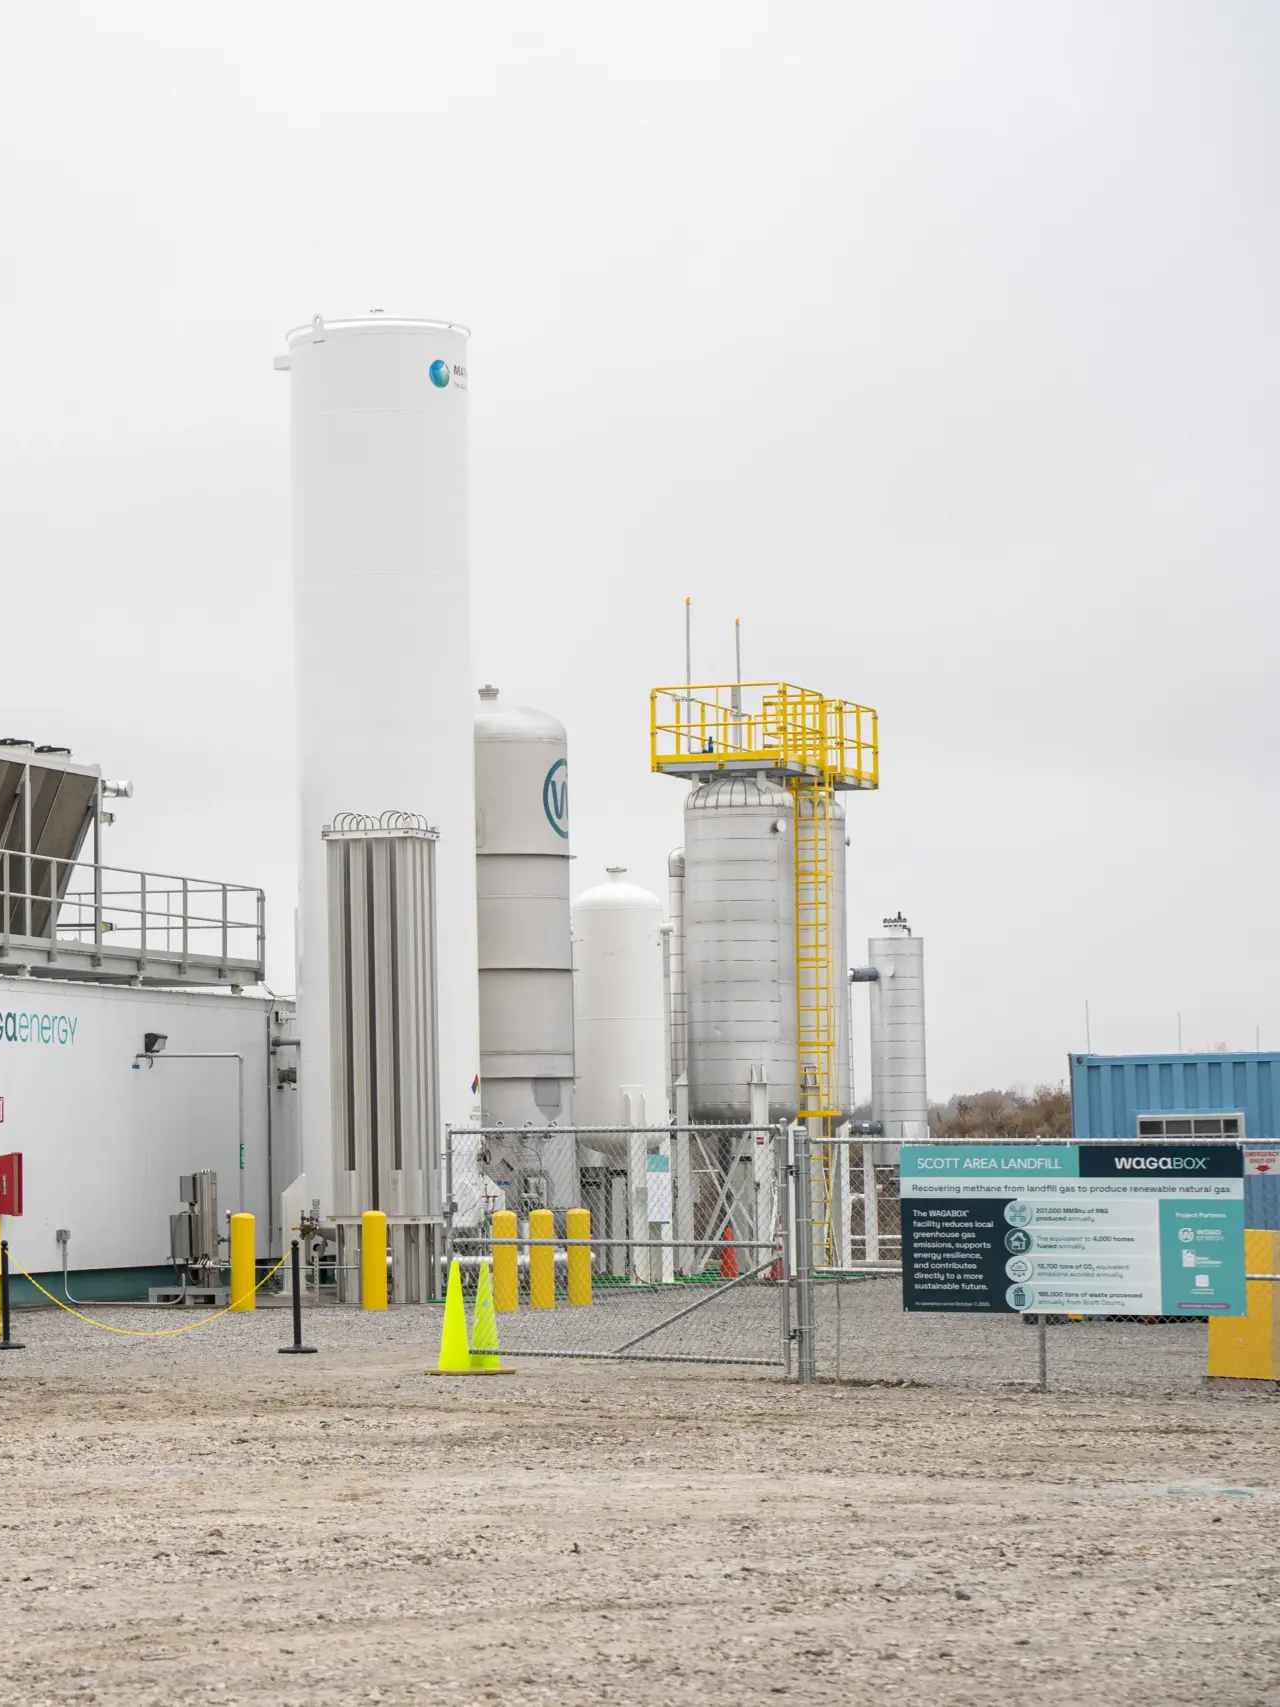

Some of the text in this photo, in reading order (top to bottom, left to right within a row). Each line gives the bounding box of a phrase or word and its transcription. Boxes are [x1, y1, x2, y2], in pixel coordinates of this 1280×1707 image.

[917, 1158, 1062, 1169] SCOTT AREA LANDFILL
[912, 1185, 960, 1194] Recovering
[963, 1185, 1002, 1193] methane
[1004, 1185, 1025, 1193] from
[1027, 1185, 1057, 1193] landfill
[1059, 1186, 1076, 1194] gas
[1090, 1185, 1127, 1195] produce
[1129, 1185, 1177, 1193] renewable
[1179, 1185, 1212, 1193] natural
[1214, 1187, 1231, 1195] gas
[912, 1209, 927, 1217] The
[913, 1220, 941, 1229] facility
[913, 1231, 960, 1239] greenhouse
[913, 1241, 954, 1249] emissions,
[914, 1272, 944, 1280] directly
